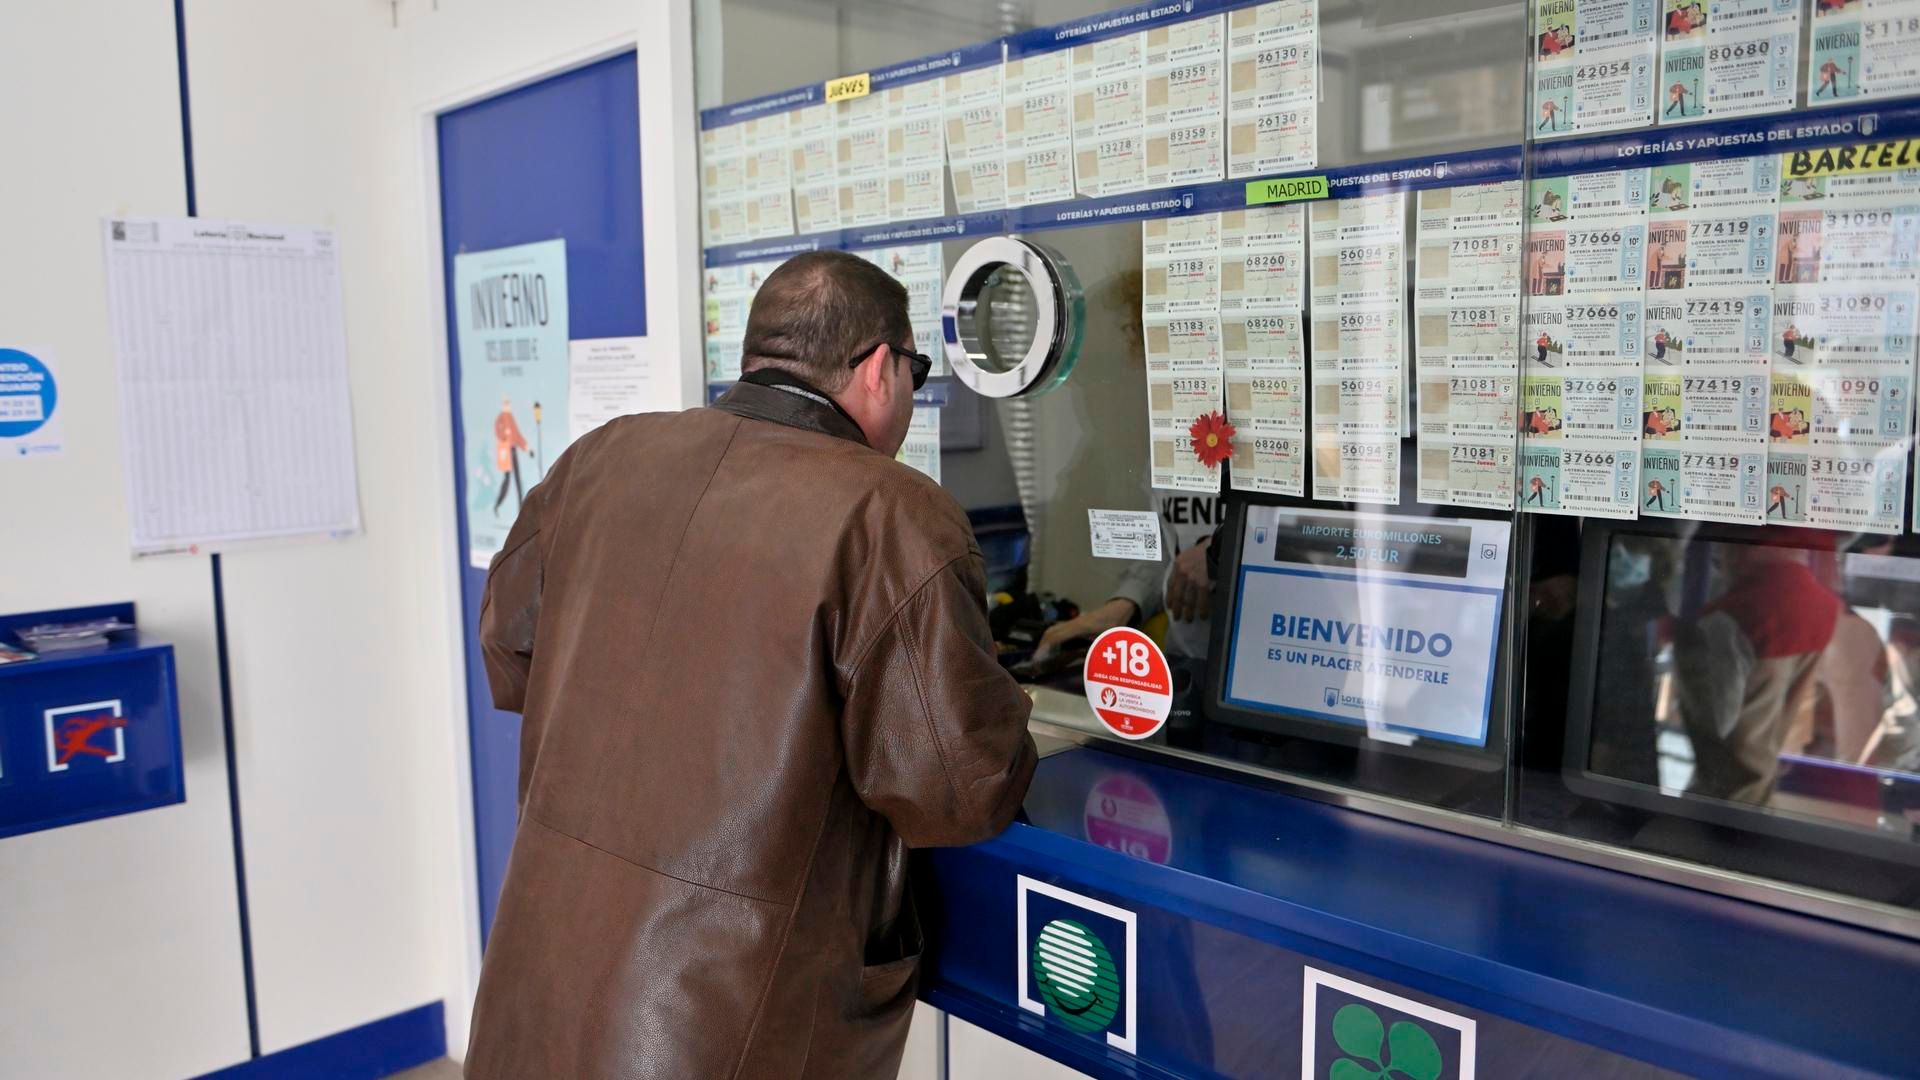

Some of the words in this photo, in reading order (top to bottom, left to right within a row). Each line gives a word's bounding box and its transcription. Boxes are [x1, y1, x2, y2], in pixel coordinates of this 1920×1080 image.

[1541, 0, 1574, 16] INVIERNO
[1055, 24, 1091, 41] LOTERÍAS
[1098, 15, 1135, 31] APUESTAS
[1136, 11, 1150, 22] DEL
[1150, 4, 1181, 18] ESTADO
[1816, 32, 1860, 51] INVIERNO
[1258, 48, 1297, 64] 26130
[1709, 42, 1769, 60] 80680
[1577, 62, 1630, 79] 42054
[1666, 56, 1704, 73] INVIERNO
[1170, 66, 1206, 80] 89359
[1538, 75, 1572, 91] INVIERNO
[1258, 113, 1297, 128] 26130
[1170, 128, 1206, 141] 89359
[1617, 141, 1683, 158] LOTERÍAS
[1685, 139, 1697, 150] Y
[1696, 132, 1763, 149] APUESTAS
[1767, 129, 1793, 142] DEL
[1796, 122, 1853, 138] ESTADO
[1372, 173, 1391, 183] DEL
[1392, 168, 1431, 181] ESTADO
[1267, 180, 1322, 199] MADRID
[1057, 210, 1093, 221] LOTERÍAS
[1099, 204, 1135, 216] APUESTAS
[1136, 202, 1150, 212] DEL
[1151, 199, 1181, 210] ESTADO
[1827, 212, 1892, 227] 31090
[1691, 221, 1748, 234] 77419
[1779, 220, 1821, 235] INVIERNO
[1569, 232, 1621, 245] 37666
[1649, 230, 1686, 244] INVIERNO
[1452, 238, 1499, 251] 71081
[1531, 239, 1564, 253] INVIERNO
[1246, 255, 1285, 267] 68260
[1340, 248, 1382, 261] 56094
[1169, 261, 1203, 272] 51183
[1687, 302, 1744, 313] 77419
[1774, 302, 1815, 316] INVIERNO
[1820, 296, 1886, 311] 31090
[1450, 309, 1497, 321] 71081
[1528, 313, 1562, 325] INVIERNO
[1566, 307, 1618, 319] 37666
[1646, 307, 1682, 320] INVIERNO
[1169, 321, 1203, 332] 51183
[1247, 318, 1284, 329] 68260
[1340, 314, 1382, 326] 56094
[1893, 337, 1903, 345] 15
[1173, 380, 1207, 390] 51183
[1252, 379, 1288, 390] 68260
[1341, 380, 1382, 391] 56094
[1451, 379, 1497, 390] 71081
[1528, 384, 1561, 396] INVIERNO
[1565, 381, 1616, 391] 37666
[1645, 383, 1680, 397] INVIERNO
[1685, 380, 1741, 390] 77419
[1255, 439, 1290, 450] 68260
[1342, 445, 1382, 456] 56094
[1451, 446, 1496, 459] 71081
[1563, 453, 1614, 464] 37666
[1526, 455, 1559, 468] INVIERNO
[1644, 457, 1679, 471] INVIERNO
[1683, 455, 1739, 467] 77419
[1811, 460, 1874, 474] 31090
[1767, 461, 1806, 476] INVIERNO
[1884, 503, 1892, 511] 15
[1302, 525, 1350, 538] IMPORTE
[1352, 528, 1442, 545] EUROMILLONES
[1336, 545, 1368, 561] 2,50
[1370, 548, 1399, 563] EUR
[1270, 613, 1452, 658] BIENVENIDO
[1103, 640, 1150, 677] +18
[1267, 648, 1282, 661] ES
[1286, 650, 1307, 664] UN
[1311, 654, 1363, 673] PLACER
[1366, 662, 1449, 685] ATENDERLE
